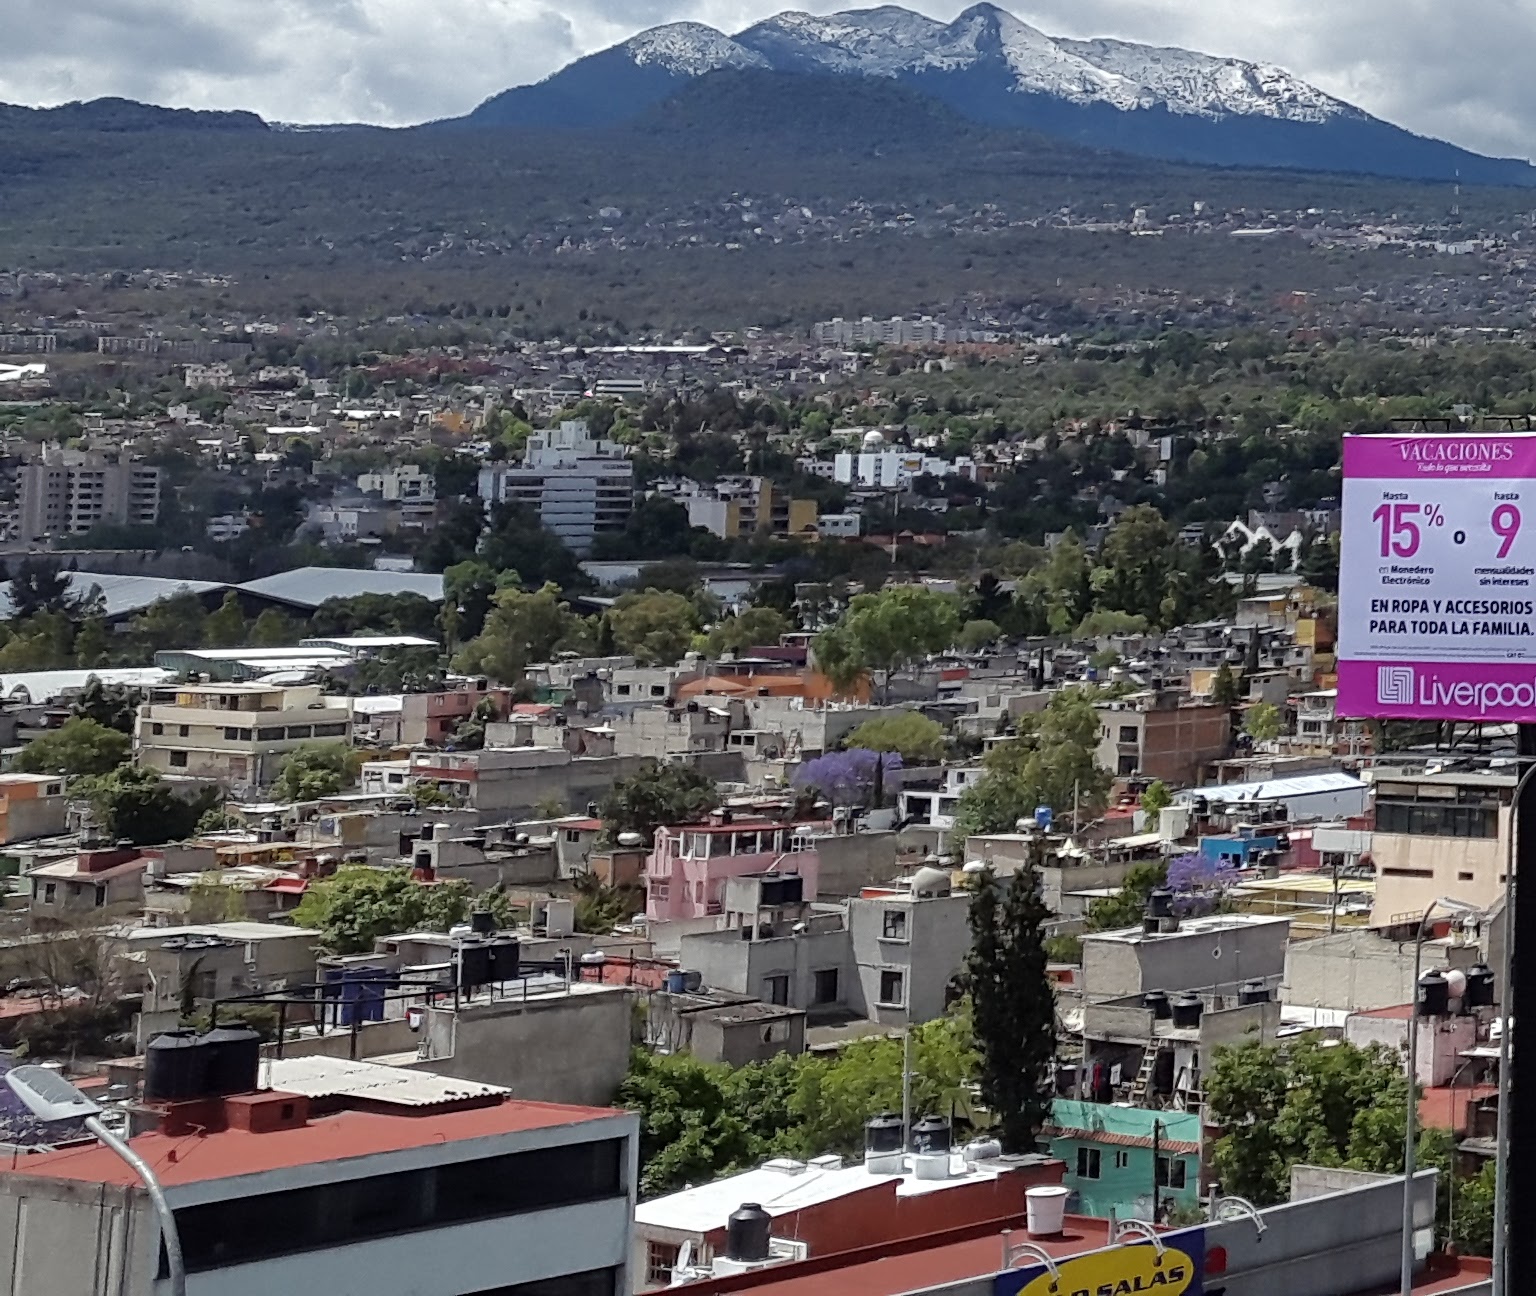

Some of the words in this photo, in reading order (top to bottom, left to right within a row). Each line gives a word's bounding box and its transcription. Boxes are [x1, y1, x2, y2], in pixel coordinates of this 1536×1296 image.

[1400, 442, 1515, 461] VACACIONES
[1383, 492, 1409, 500] Hasta
[1494, 492, 1520, 501] hasta
[1453, 530, 1466, 545] o
[1491, 503, 1521, 559] 9
[1391, 565, 1434, 574] Monedero
[1474, 566, 1535, 575] mensualidades
[1480, 577, 1491, 586] sin
[1492, 577, 1529, 586] intereses
[1371, 599, 1389, 613] EN
[1392, 599, 1429, 613] ROPA
[1433, 599, 1442, 613] Y
[1445, 600, 1533, 615] ACCESORIOS
[1369, 620, 1407, 634] PARA
[1411, 620, 1448, 634] TODA
[1452, 621, 1469, 635] LA
[1473, 621, 1535, 636] FAMILIA.
[1096, 1265, 1184, 1296] SALAS
